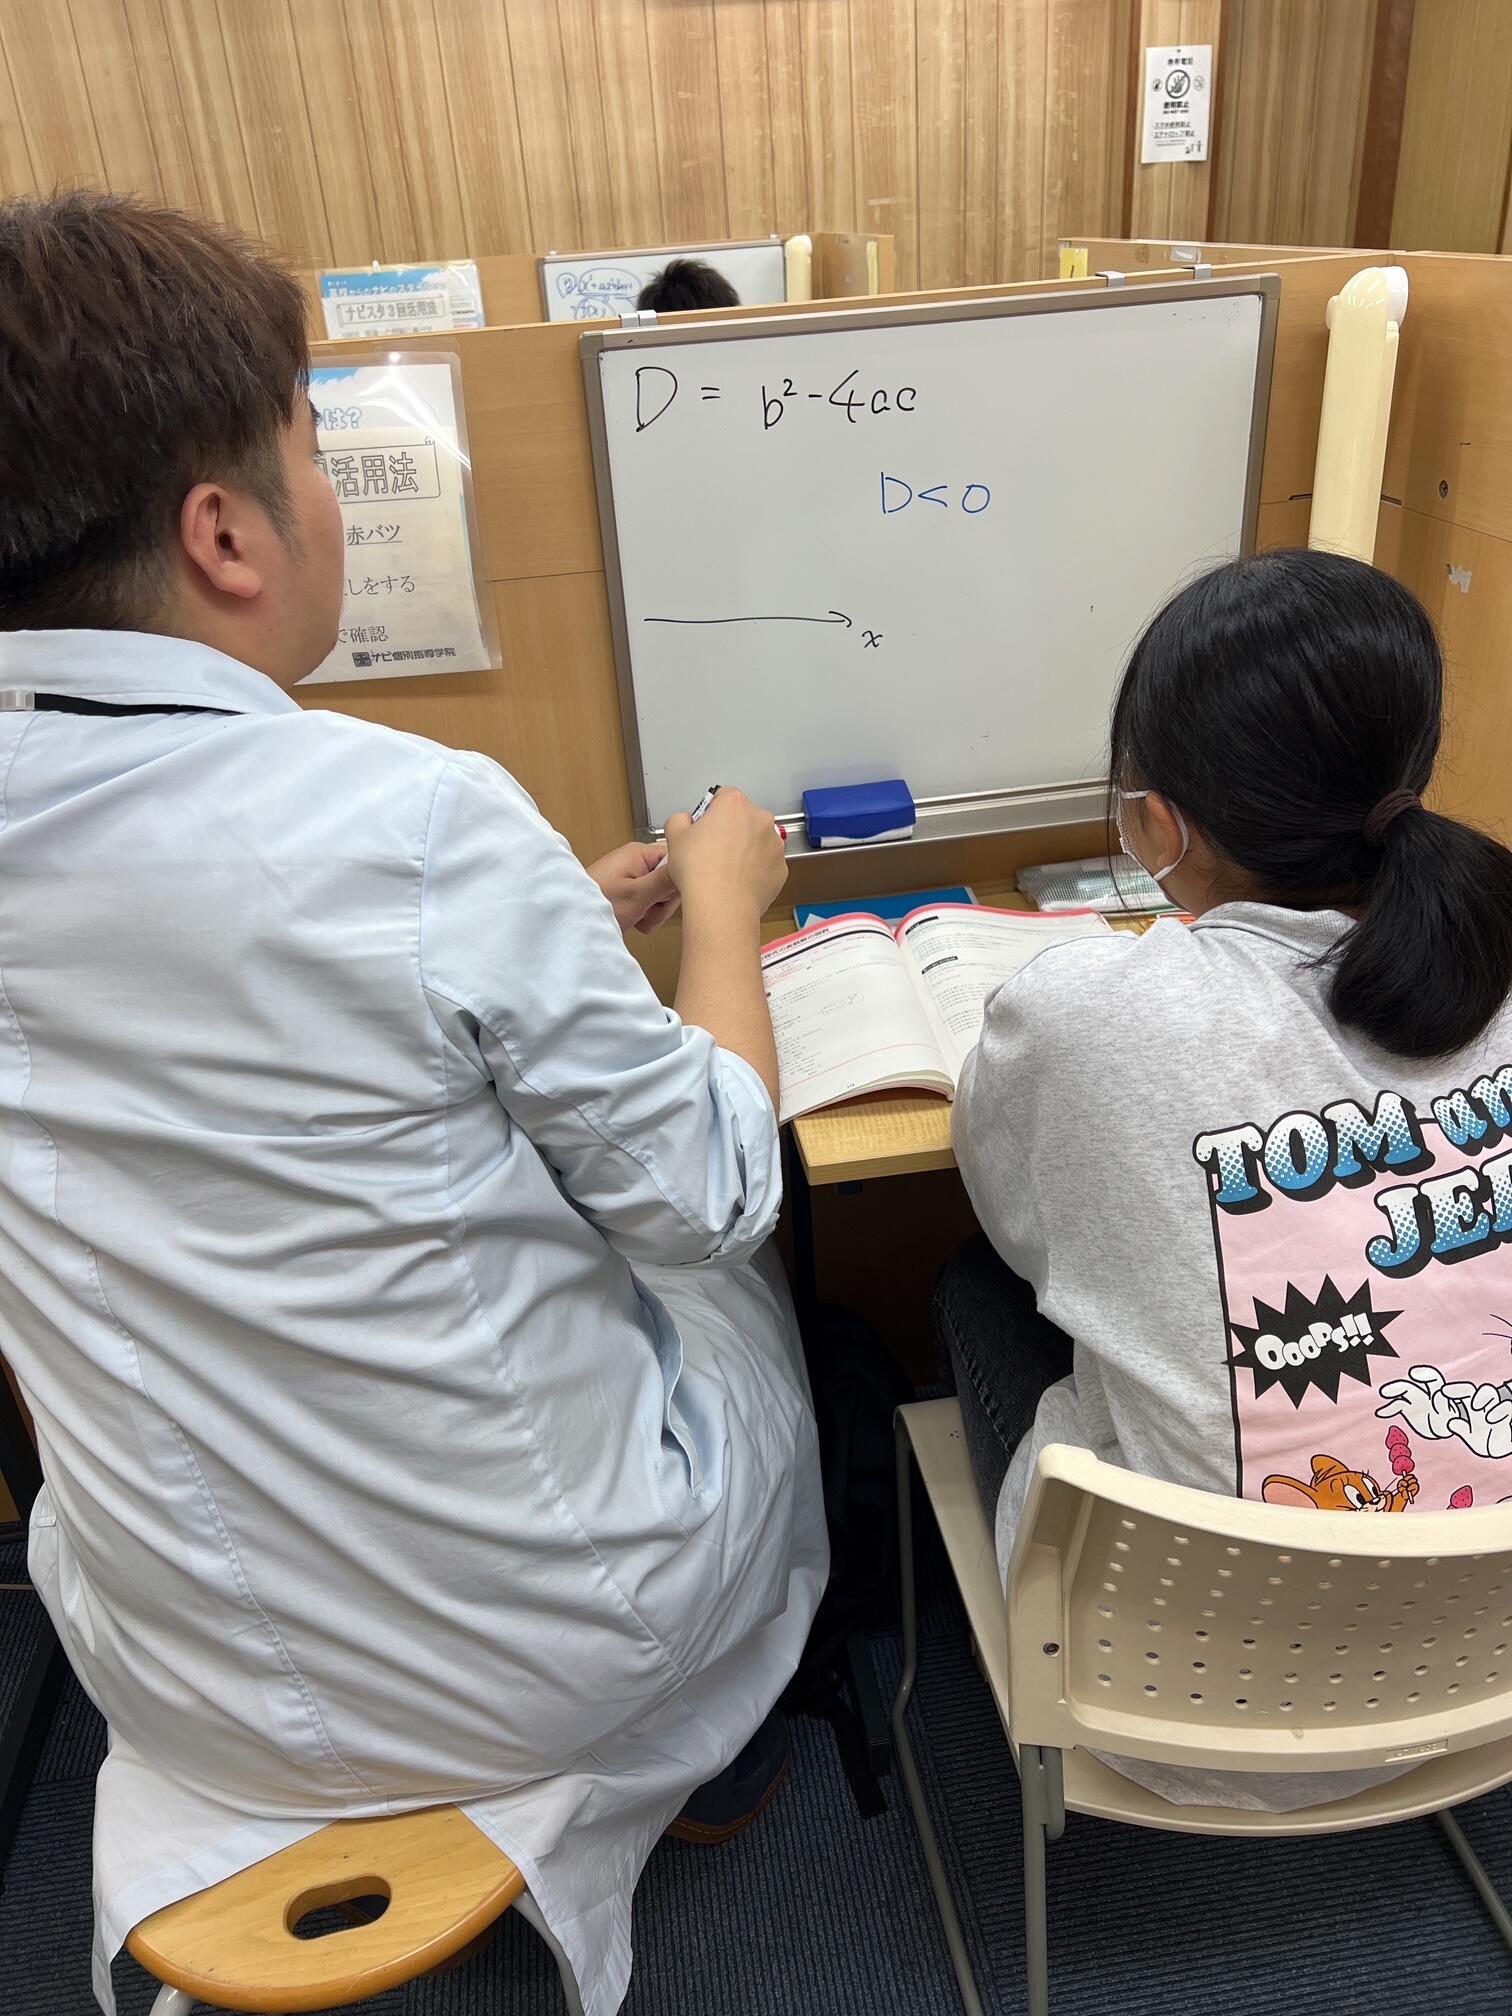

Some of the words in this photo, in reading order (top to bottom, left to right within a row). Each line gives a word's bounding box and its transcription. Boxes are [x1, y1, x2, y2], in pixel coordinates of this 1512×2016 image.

[635, 367, 679, 432] D
[316, 406, 362, 431] は?
[346, 524, 401, 545] 赤バツ
[344, 575, 416, 597] しをする
[861, 630, 884, 649] x
[371, 648, 456, 662] ナビ個別指導学院
[1193, 1090, 1435, 1214] TOM
